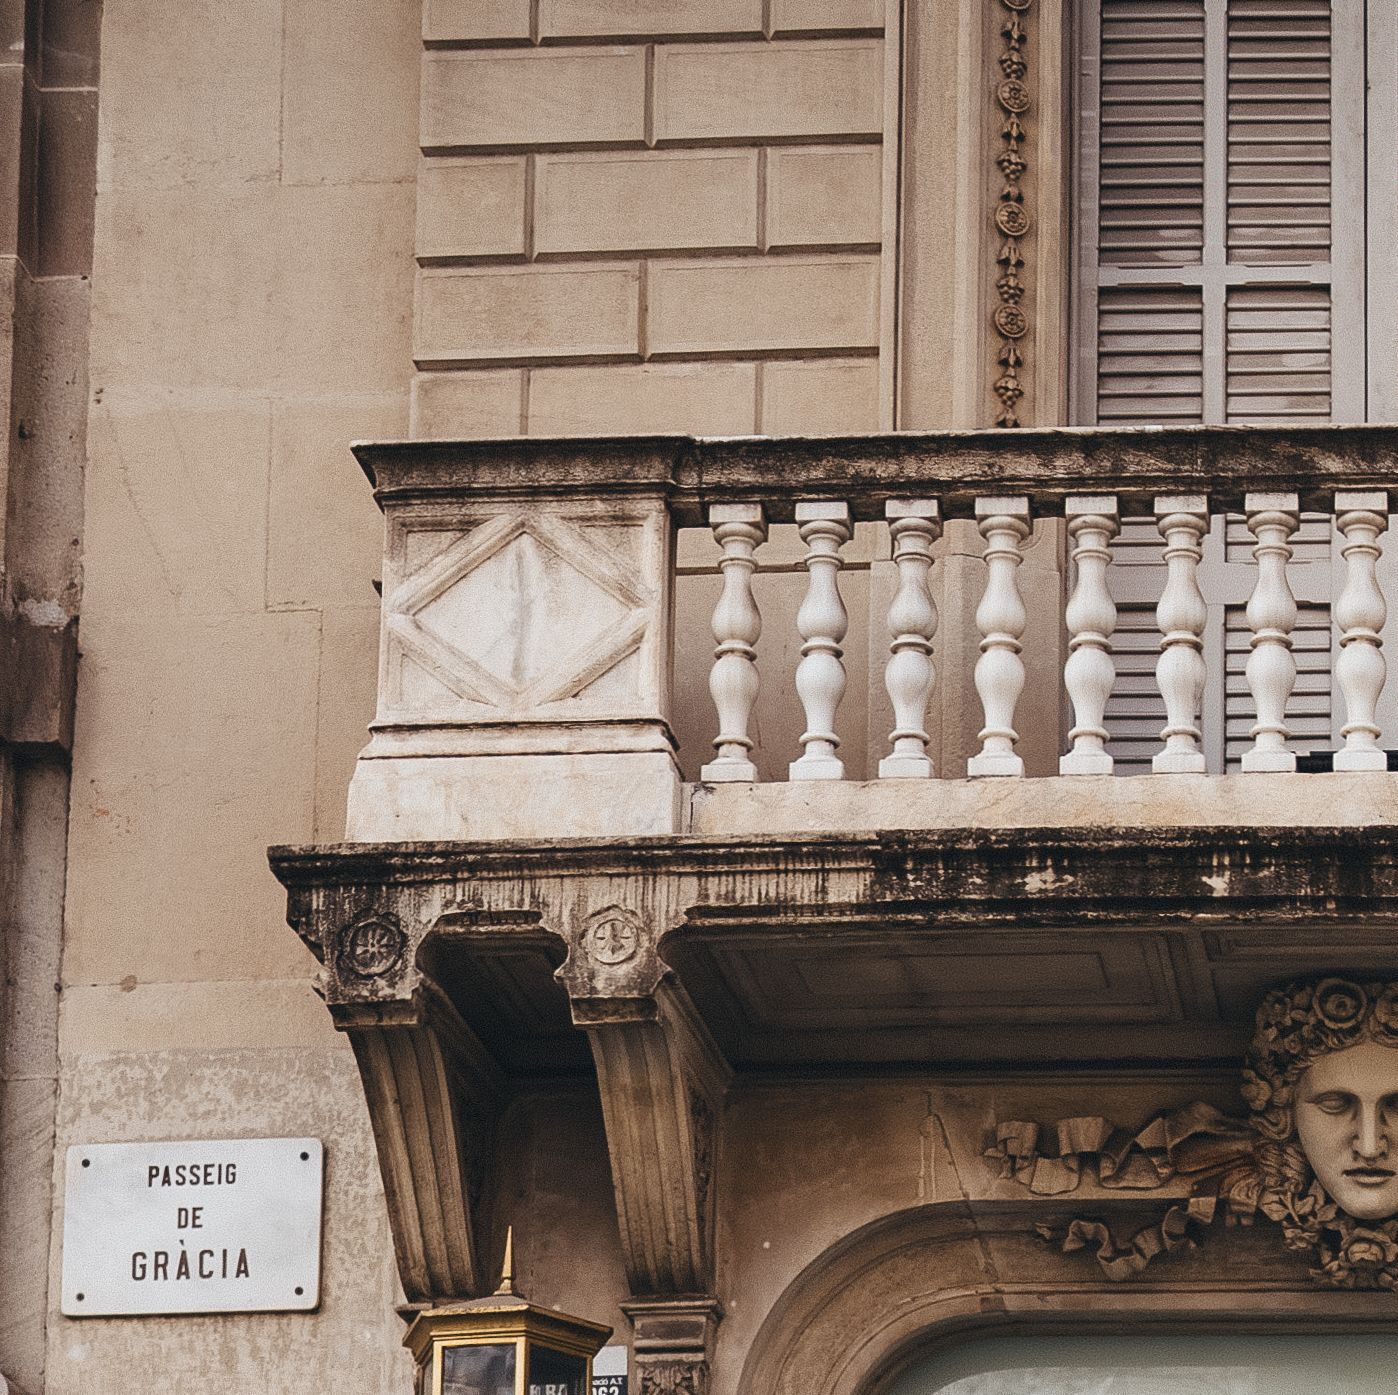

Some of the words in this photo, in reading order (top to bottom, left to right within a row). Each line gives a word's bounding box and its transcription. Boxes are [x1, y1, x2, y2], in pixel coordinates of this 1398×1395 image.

[148, 1163, 237, 1188] PASSEIG
[177, 1207, 204, 1229] DE
[131, 1239, 250, 1281] GRÀCIA
